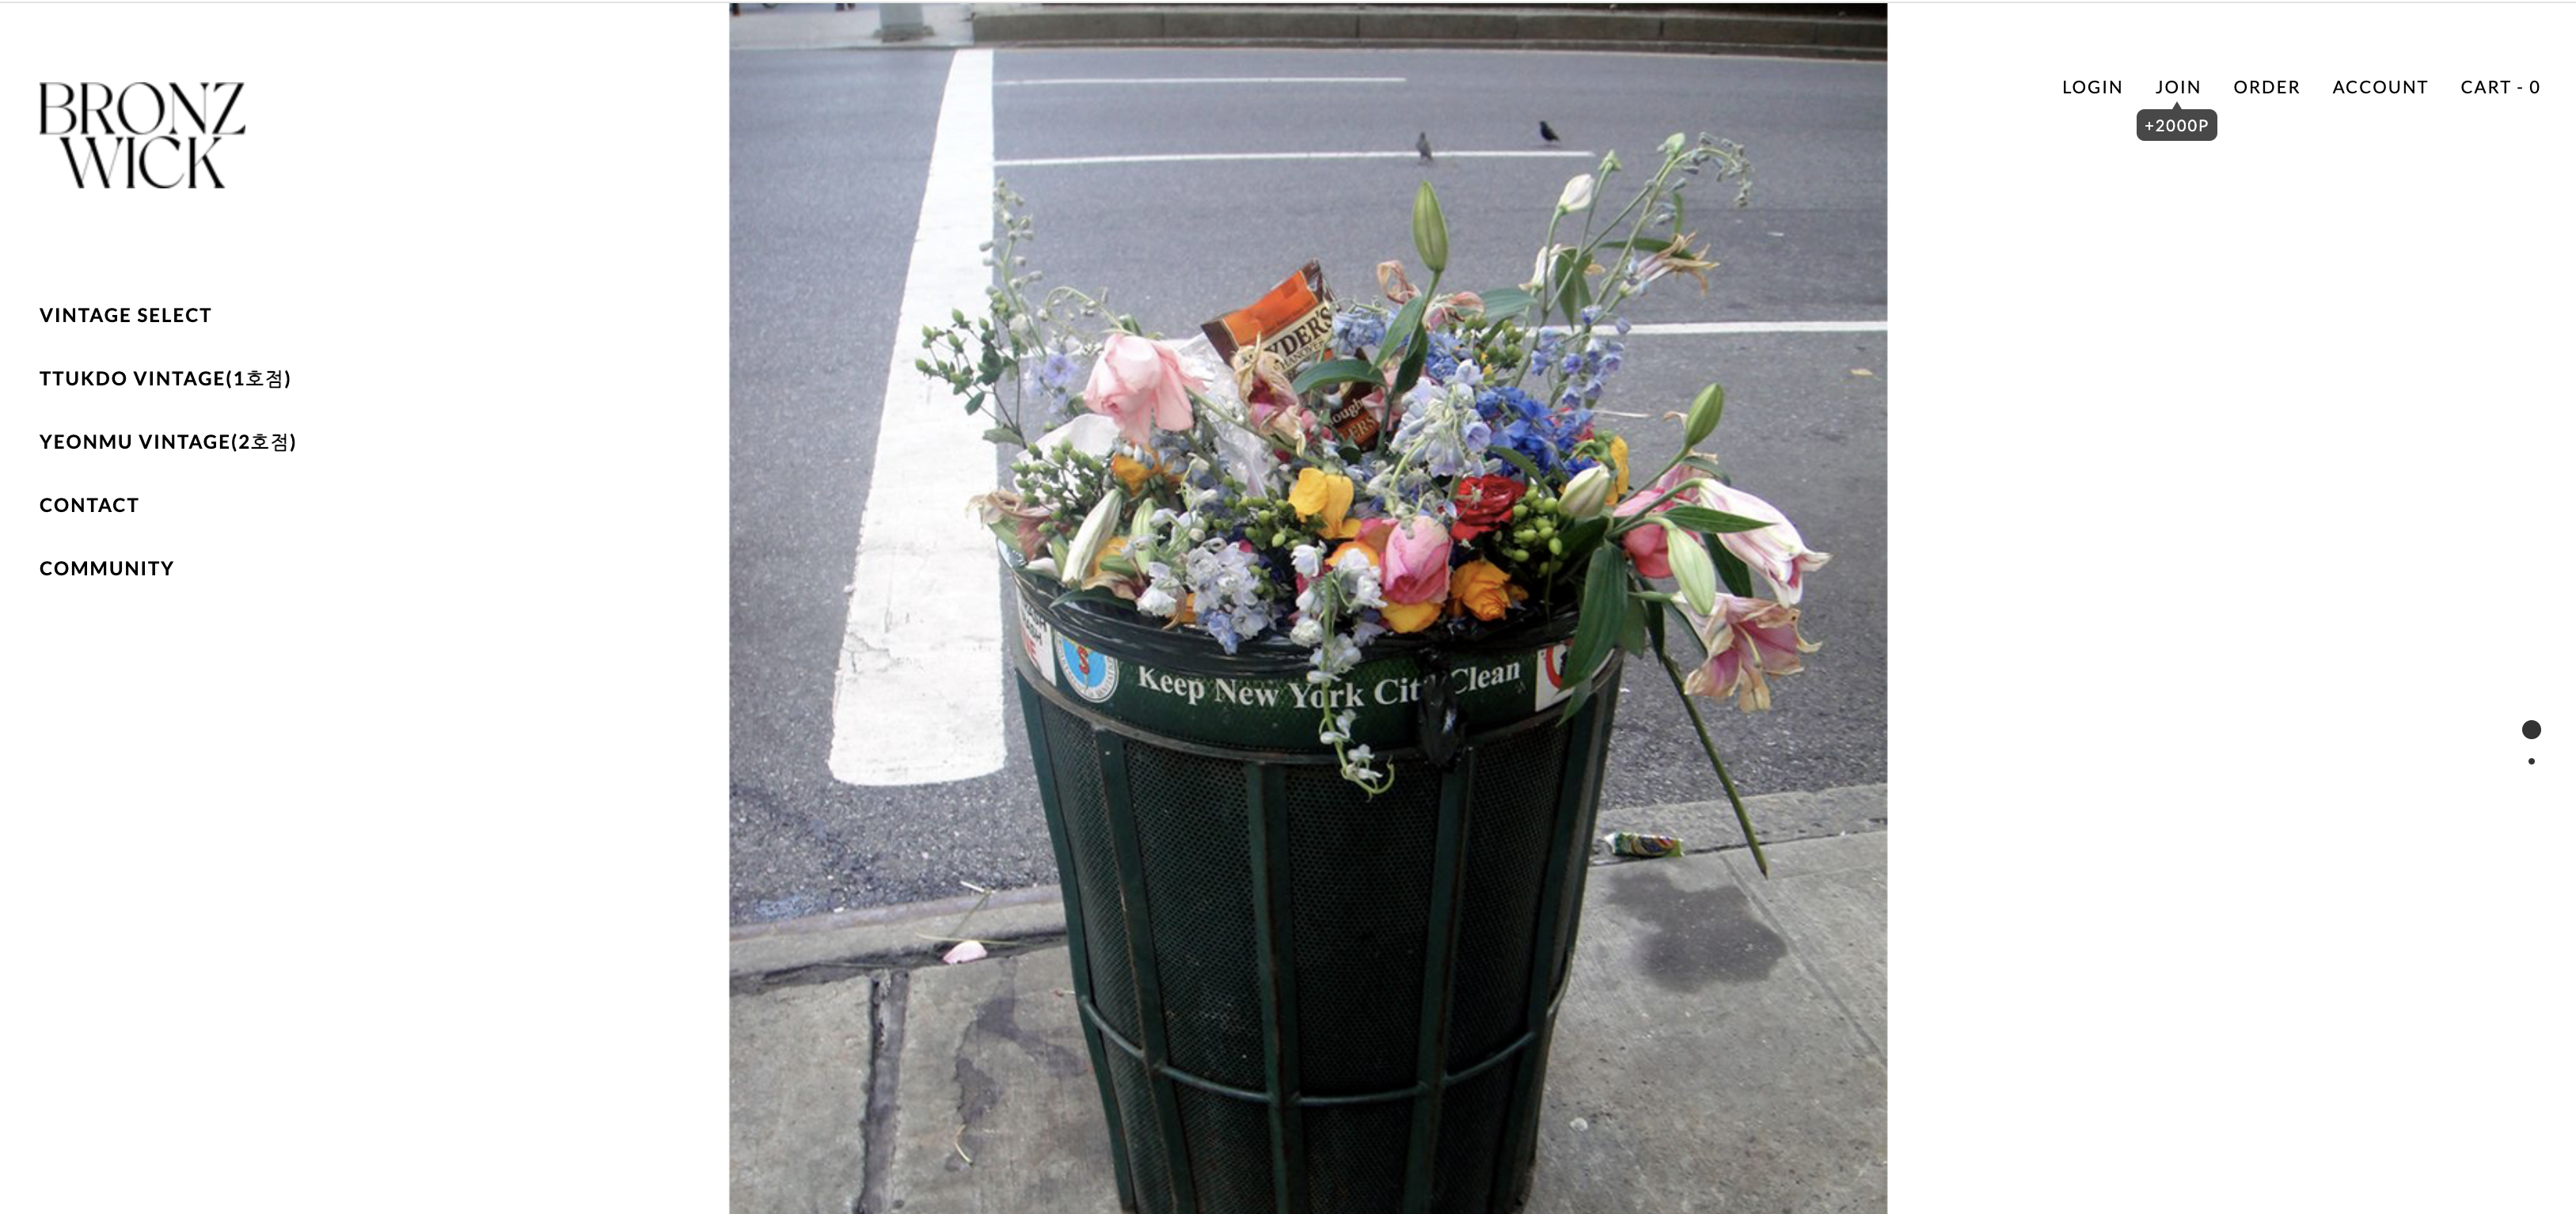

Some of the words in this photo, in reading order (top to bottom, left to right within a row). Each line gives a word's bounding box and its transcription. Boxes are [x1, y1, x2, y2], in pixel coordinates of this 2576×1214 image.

[2062, 80, 2122, 94] LOGIN
[2155, 80, 2200, 94] JOIN
[2234, 80, 2301, 94] ORDER
[2332, 80, 2429, 94] ACCOUNT
[2461, 80, 2511, 94] CART
[2529, 80, 2540, 94] 0
[40, 82, 246, 135] BRONZ
[2145, 119, 2209, 132] +2000P
[59, 136, 226, 189] WICK
[40, 307, 131, 323] VINTAGE
[138, 307, 211, 323] SELECT
[40, 370, 127, 386] TTUKDO
[134, 370, 291, 389] VINTAGE(1호점)
[1330, 398, 1363, 426] ough
[40, 434, 131, 450] YEONMU
[139, 433, 295, 453] VINTAGE(2호점)
[40, 497, 139, 513] CONTACT
[40, 560, 174, 576] COMMUNITY
[1138, 666, 1204, 705] Keep
[1215, 678, 1279, 708] New
[1288, 681, 1365, 709] York
[1373, 677, 1427, 705] Cit
[1451, 662, 1520, 695] Clean
